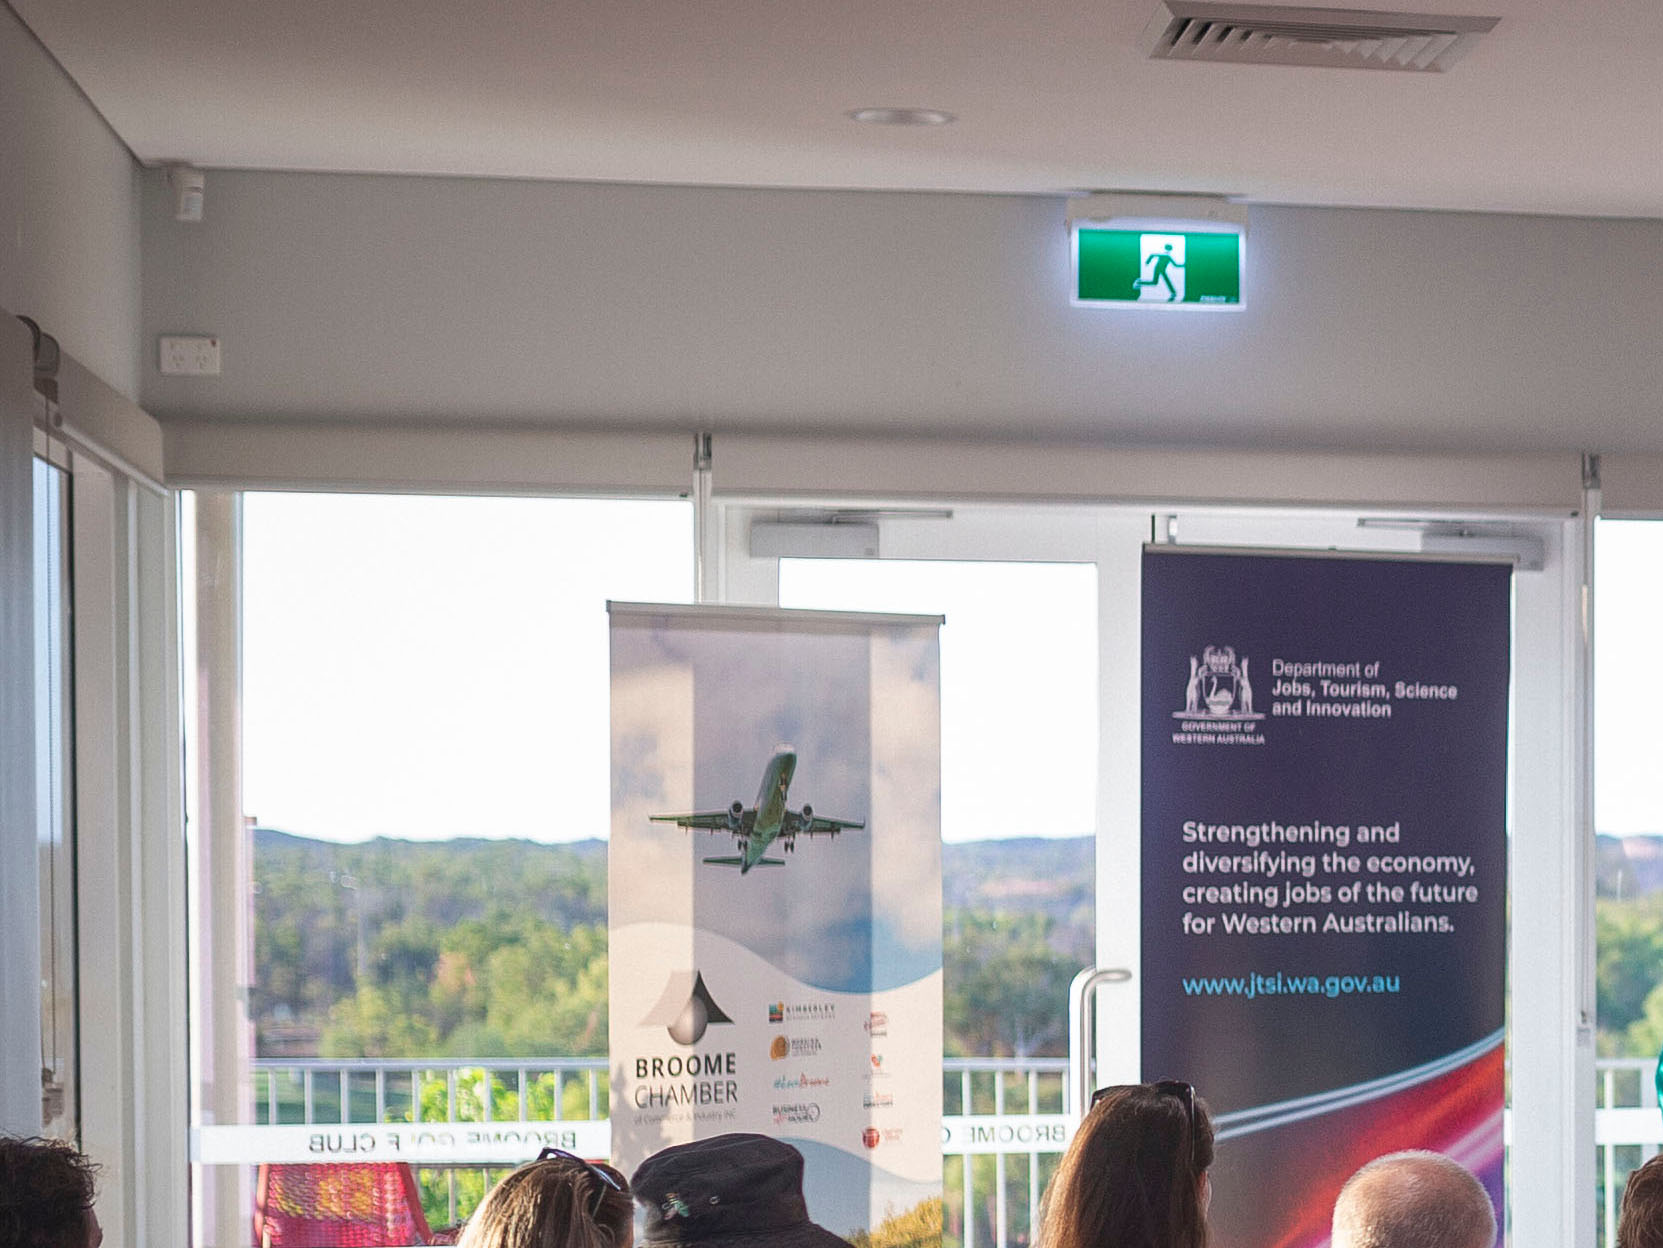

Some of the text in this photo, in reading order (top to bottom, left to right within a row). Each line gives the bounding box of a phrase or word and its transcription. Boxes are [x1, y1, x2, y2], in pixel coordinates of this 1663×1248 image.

[1272, 658, 1380, 680] Department of
[1272, 679, 1458, 700] Jobs, Tourism, Science
[1272, 699, 1392, 718] and Innovation
[1182, 820, 1401, 848] Strengthening and
[1182, 850, 1476, 878] diversifying the economy,
[1182, 881, 1479, 908] creating jobs of the future
[1182, 911, 1455, 935] for Western Australians.
[1182, 971, 1401, 999] www.jtsi.wa.gov.au
[636, 1052, 736, 1078] BROOME
[635, 1080, 738, 1109] CHAMBER
